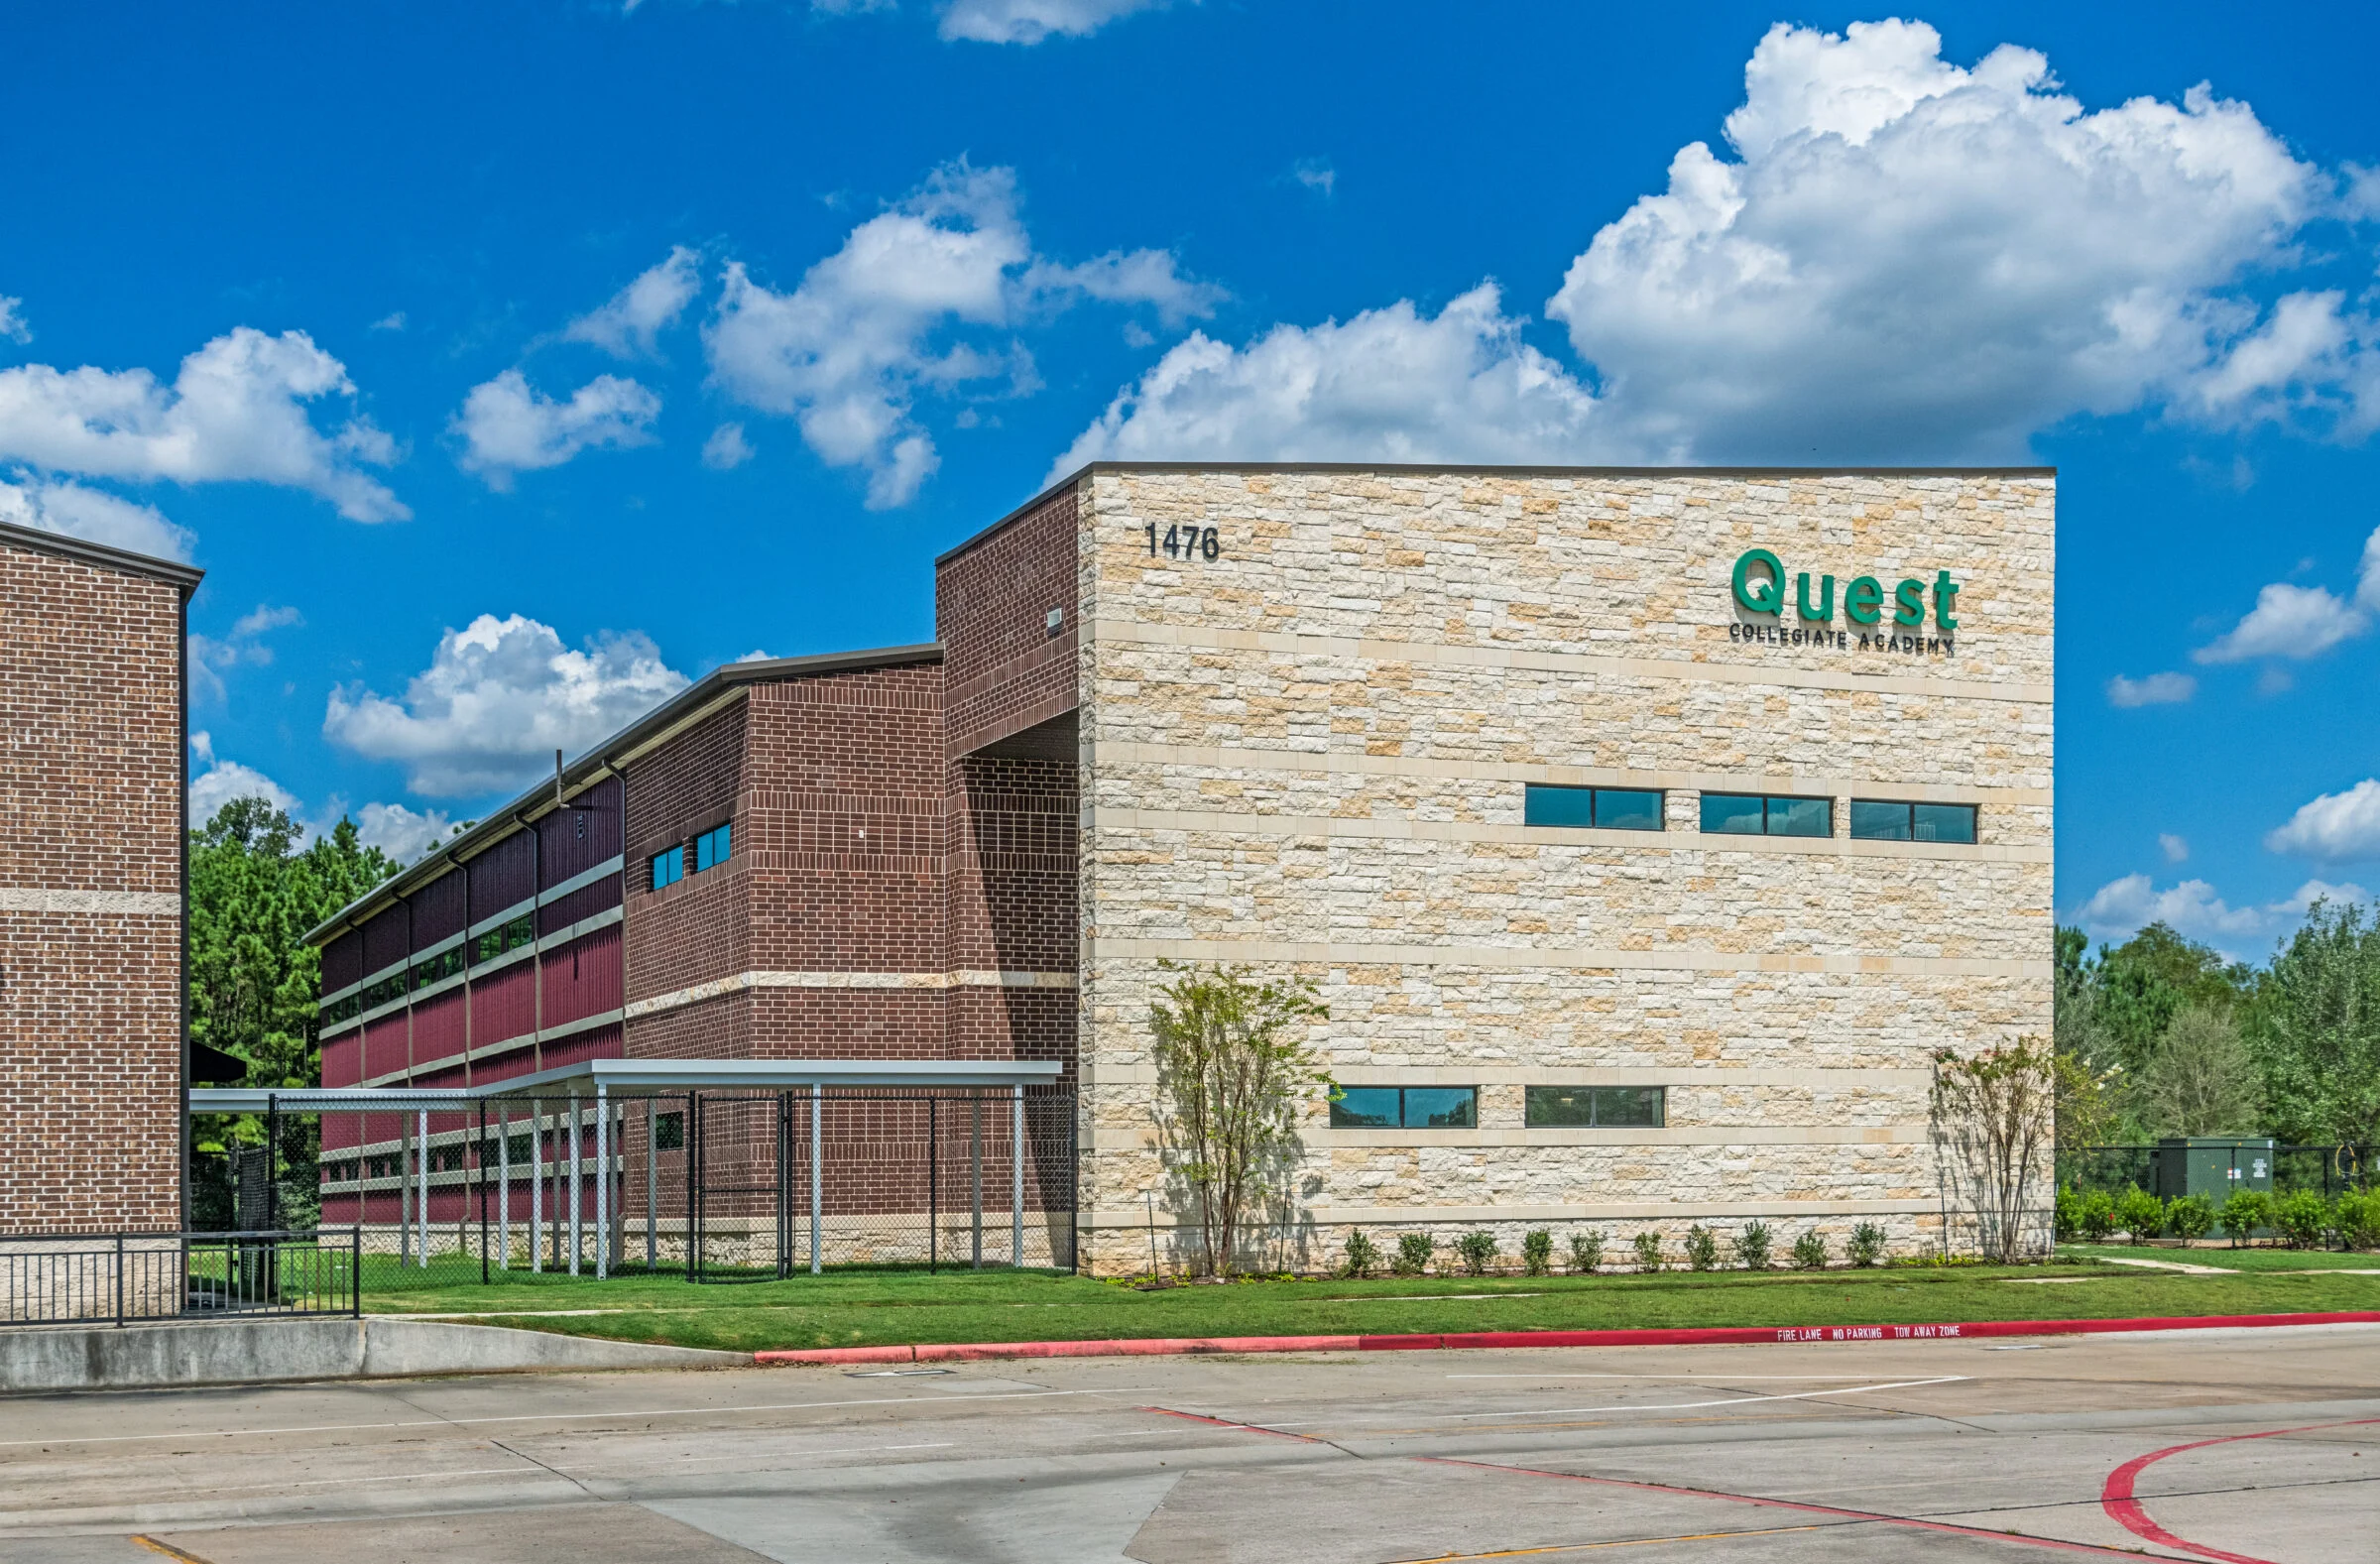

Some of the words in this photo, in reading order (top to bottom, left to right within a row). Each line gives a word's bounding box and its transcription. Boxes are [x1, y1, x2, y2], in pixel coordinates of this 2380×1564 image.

[1145, 522, 1219, 558] 1476
[1732, 548, 1960, 630] Quest
[1729, 623, 1846, 645] COLLEGIATE
[1858, 633, 1955, 656] ACADEMY
[1777, 1329, 1797, 1342] FIRE
[1799, 1328, 1822, 1341] LANE
[1833, 1329, 1844, 1340] NO
[1846, 1328, 1882, 1340] PARKING
[1894, 1326, 1910, 1338] TOW
[1914, 1327, 1936, 1338] AWAY
[1939, 1325, 1961, 1337] ZONE
